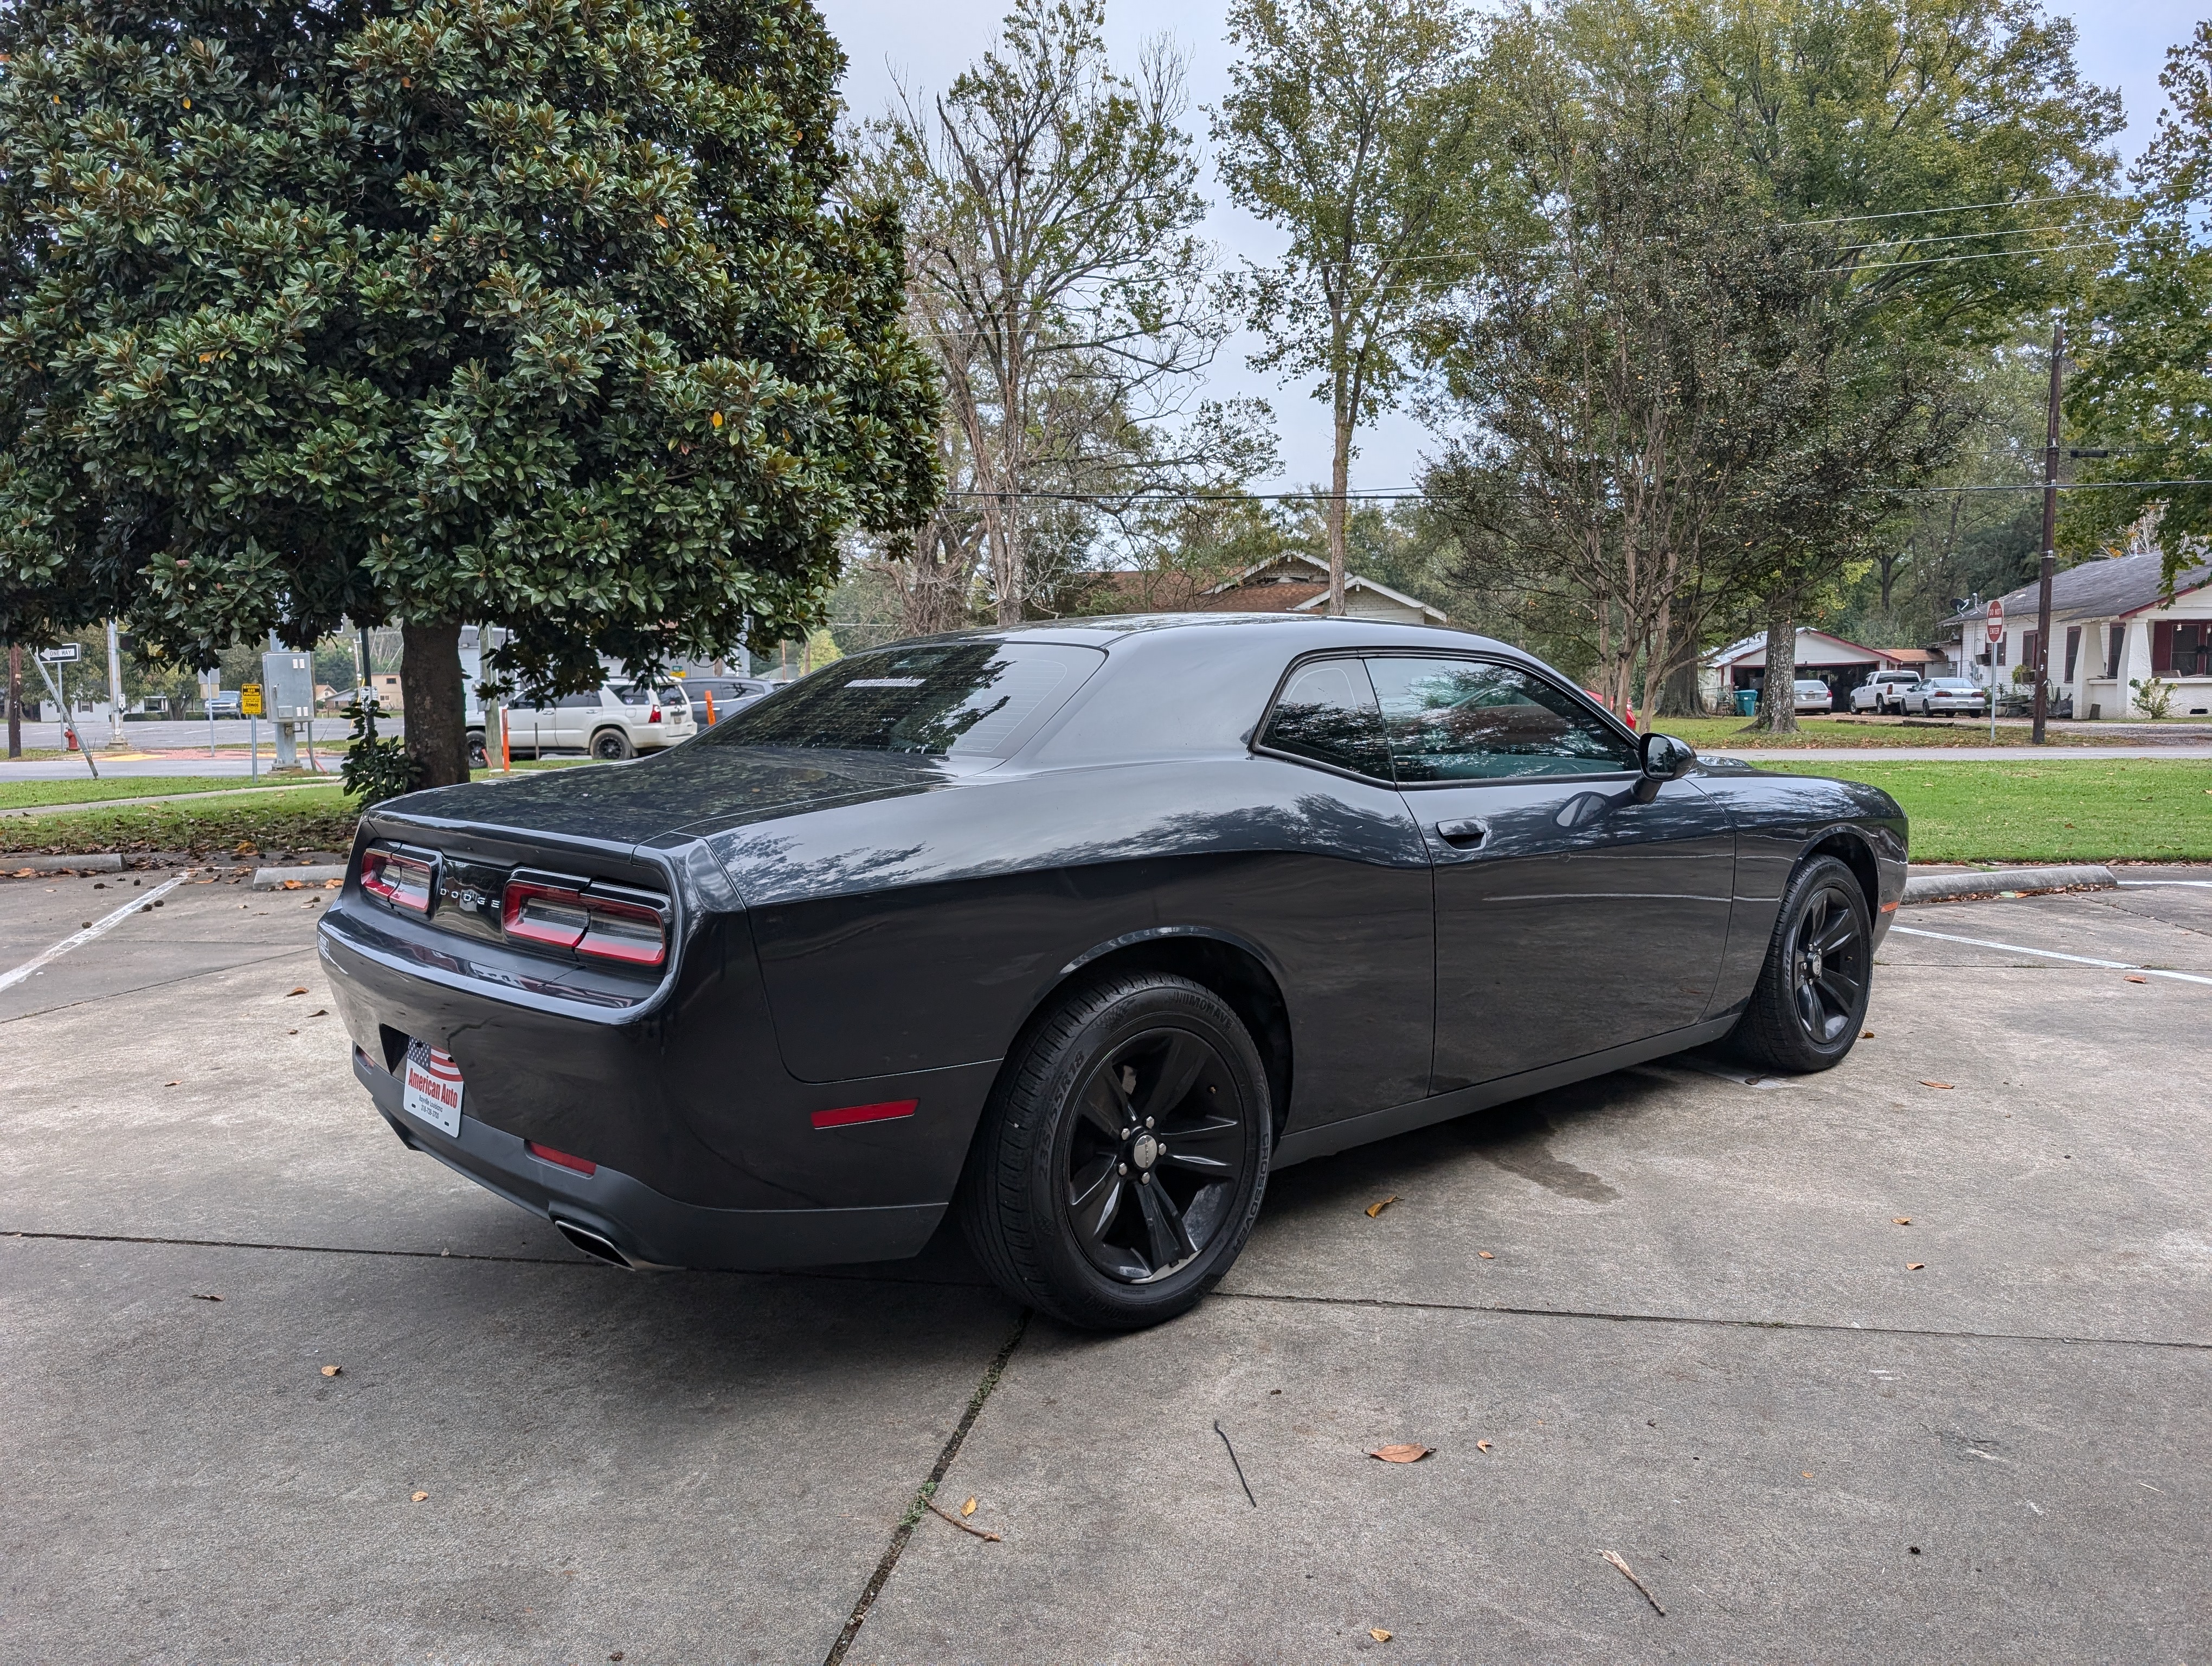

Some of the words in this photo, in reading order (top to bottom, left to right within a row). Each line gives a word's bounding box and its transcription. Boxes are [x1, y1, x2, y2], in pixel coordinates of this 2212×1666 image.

[440, 888, 500, 908] DODGE
[408, 1067, 441, 1101] American
[441, 1082, 458, 1109] Auto
[1232, 1132, 1269, 1252] CROSSOVER
